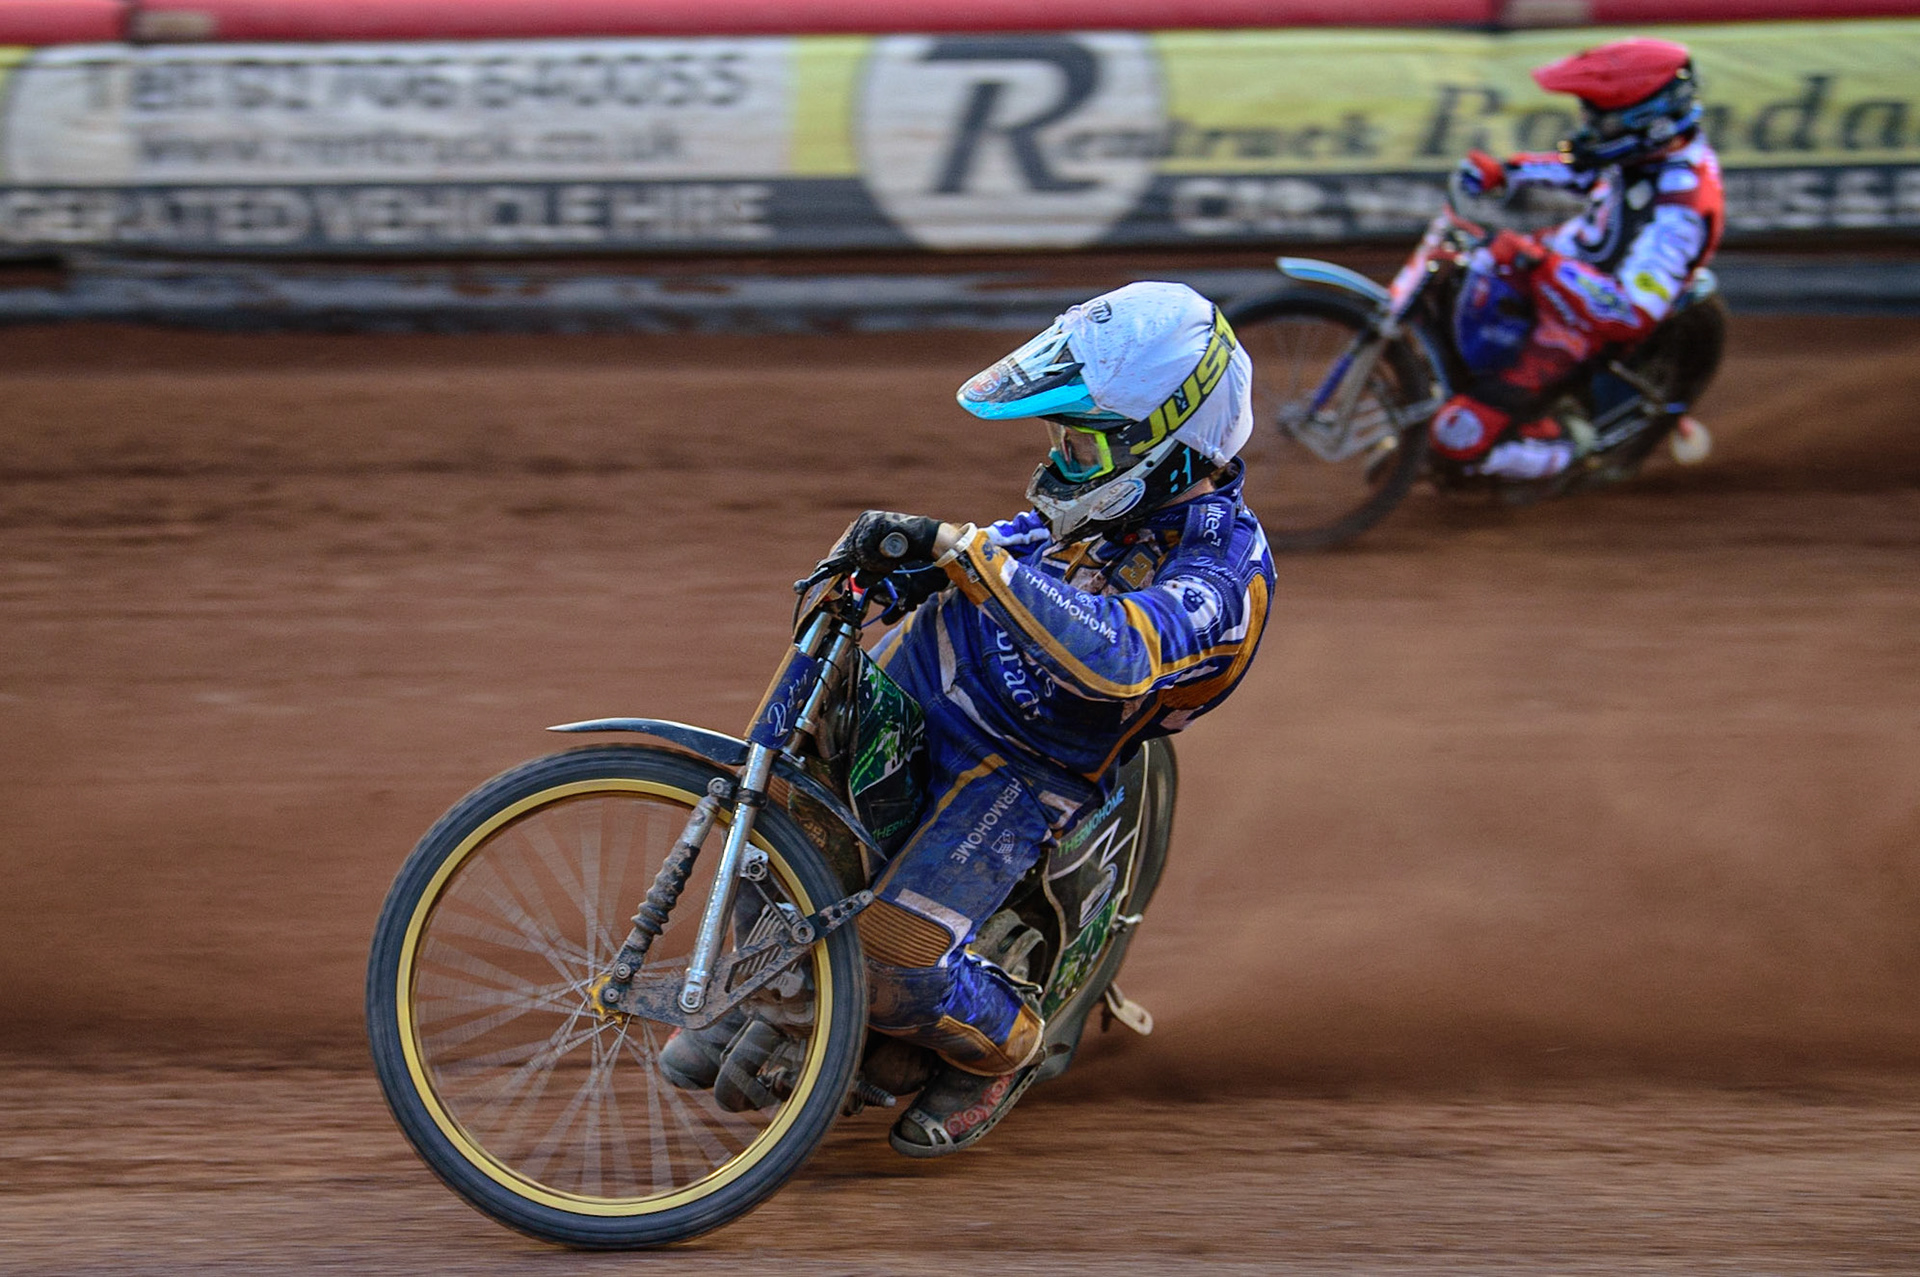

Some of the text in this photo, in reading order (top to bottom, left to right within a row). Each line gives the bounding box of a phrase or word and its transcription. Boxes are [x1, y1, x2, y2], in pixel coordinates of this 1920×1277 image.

[318, 186, 601, 243] VEHICLE
[614, 184, 770, 241] HIRE
[1024, 567, 1118, 645] THERMOHOME
[950, 777, 1023, 865] HERMOHOME
[1058, 786, 1126, 858] THERMOHOME
